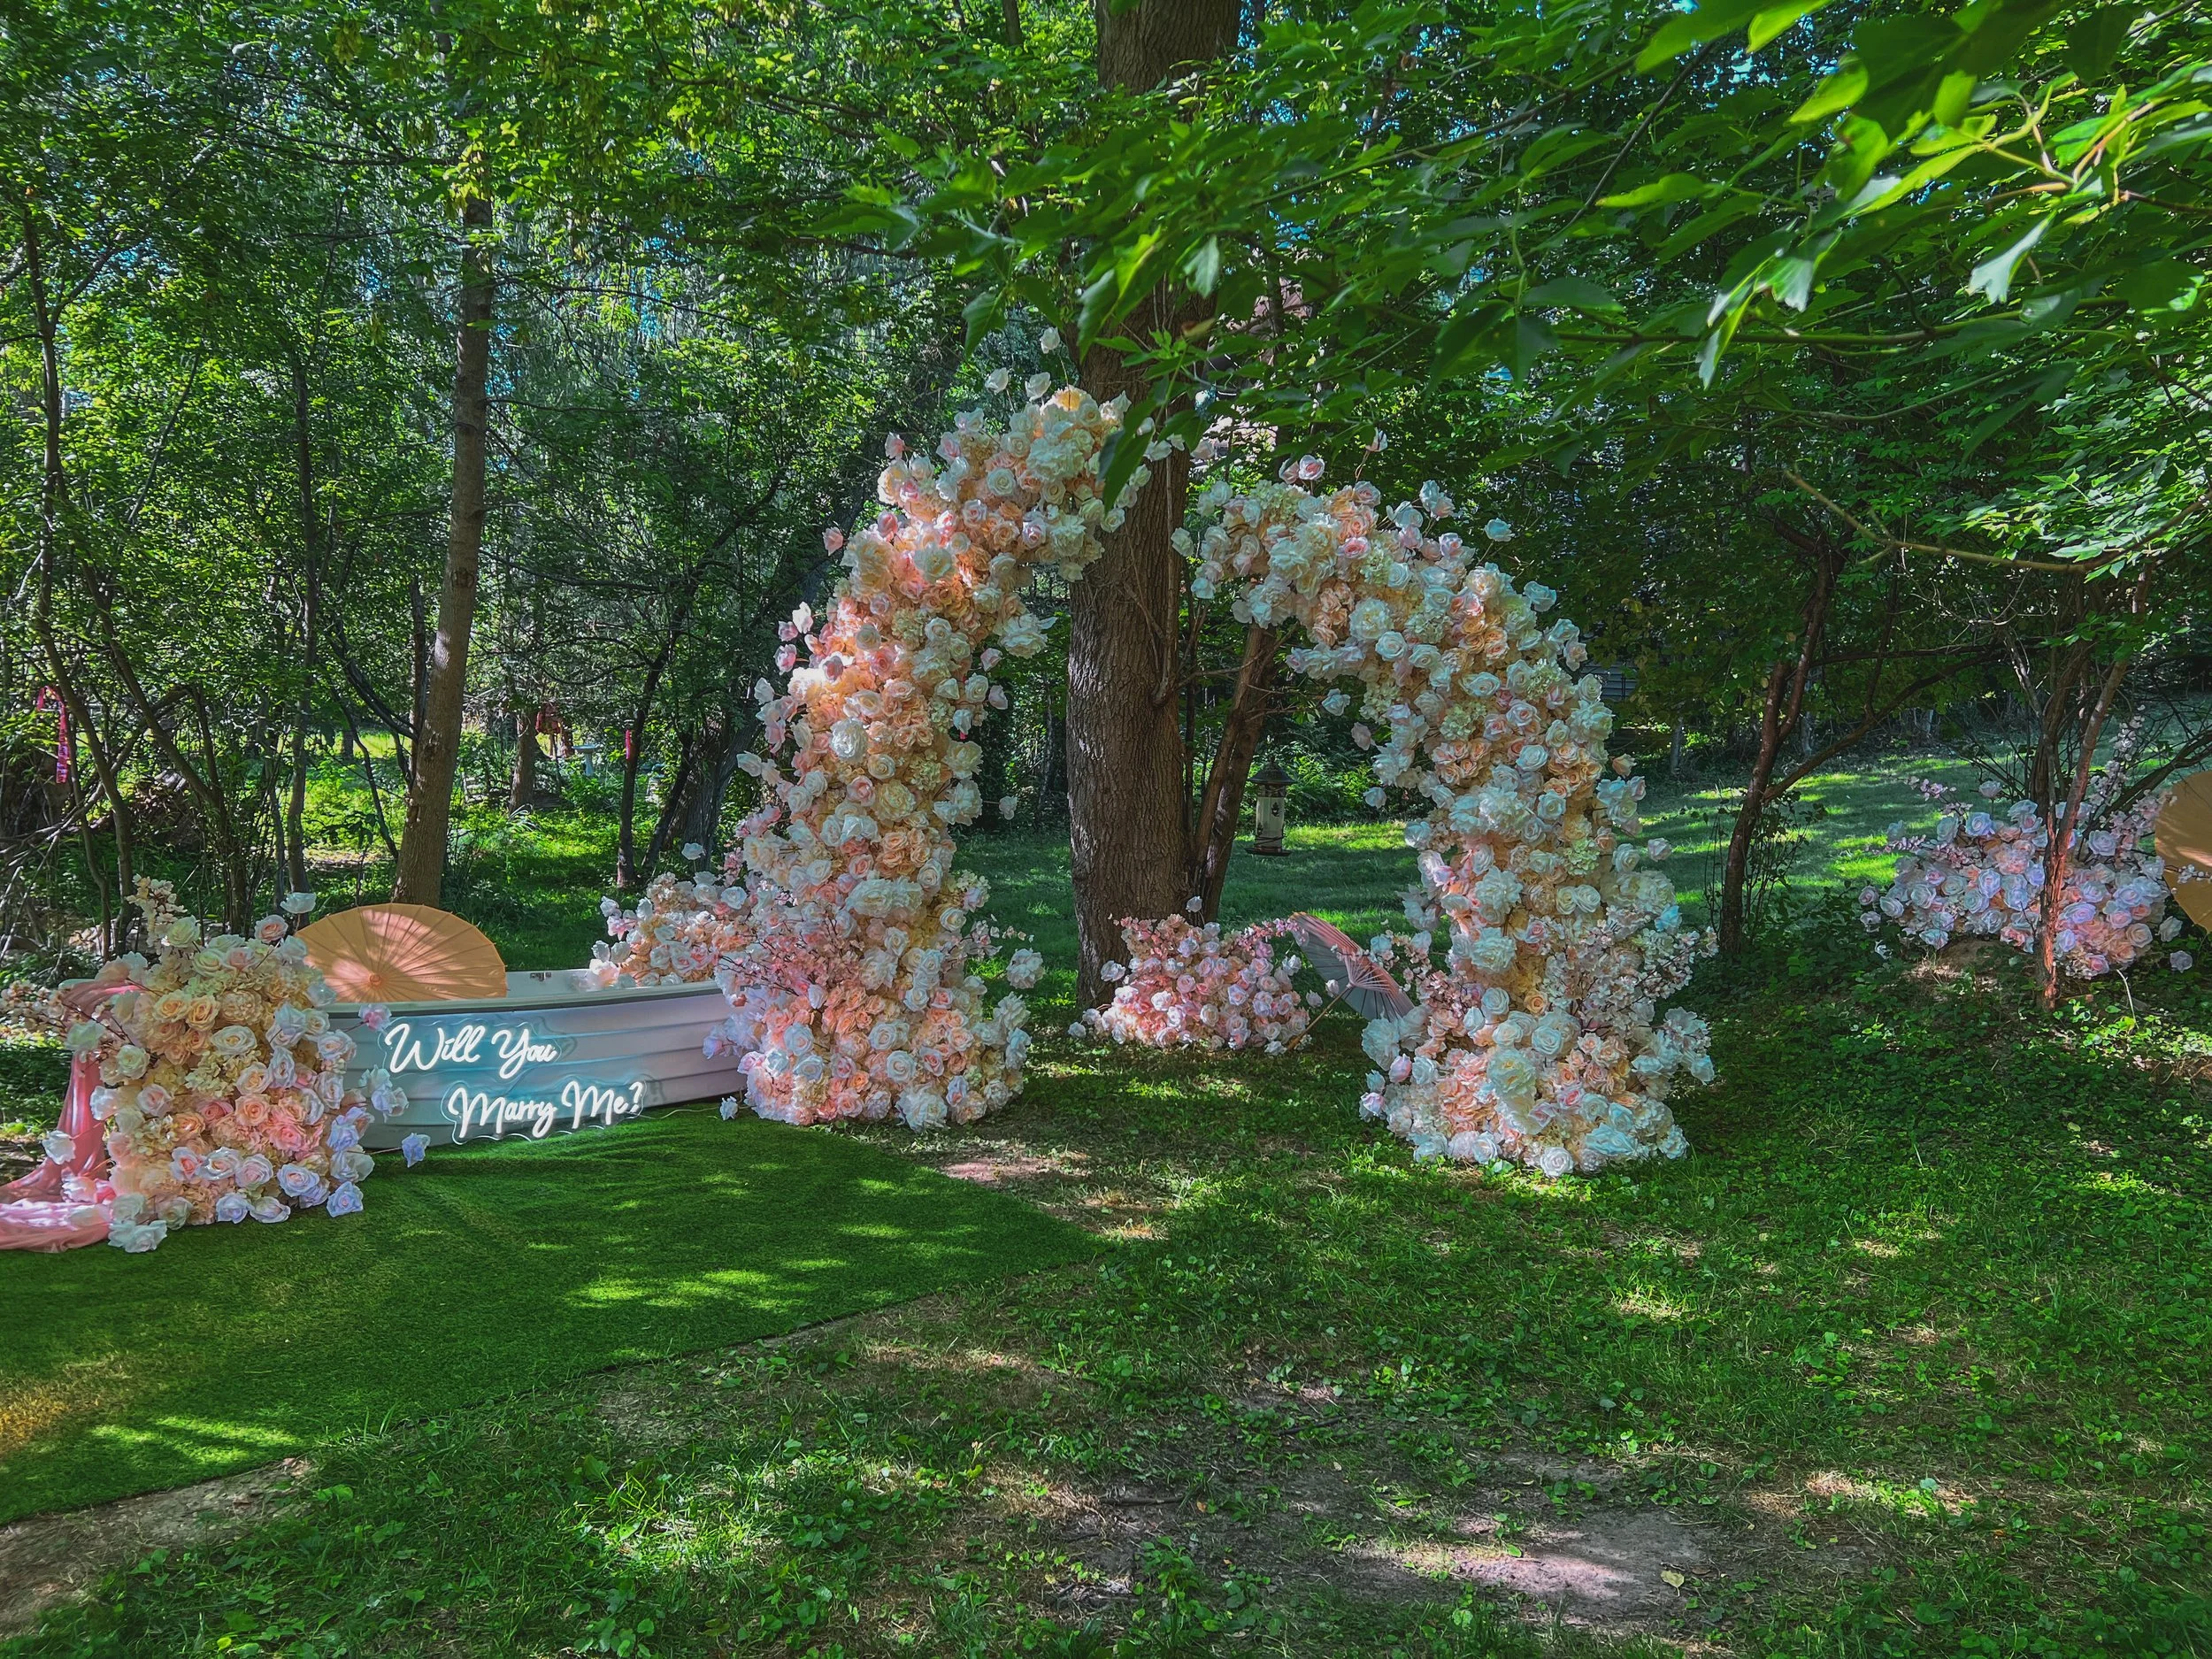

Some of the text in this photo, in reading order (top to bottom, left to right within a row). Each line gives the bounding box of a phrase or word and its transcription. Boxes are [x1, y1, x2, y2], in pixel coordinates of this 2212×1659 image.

[386, 1024, 557, 1079] Will You
[449, 1081, 644, 1138] Marry Me?
